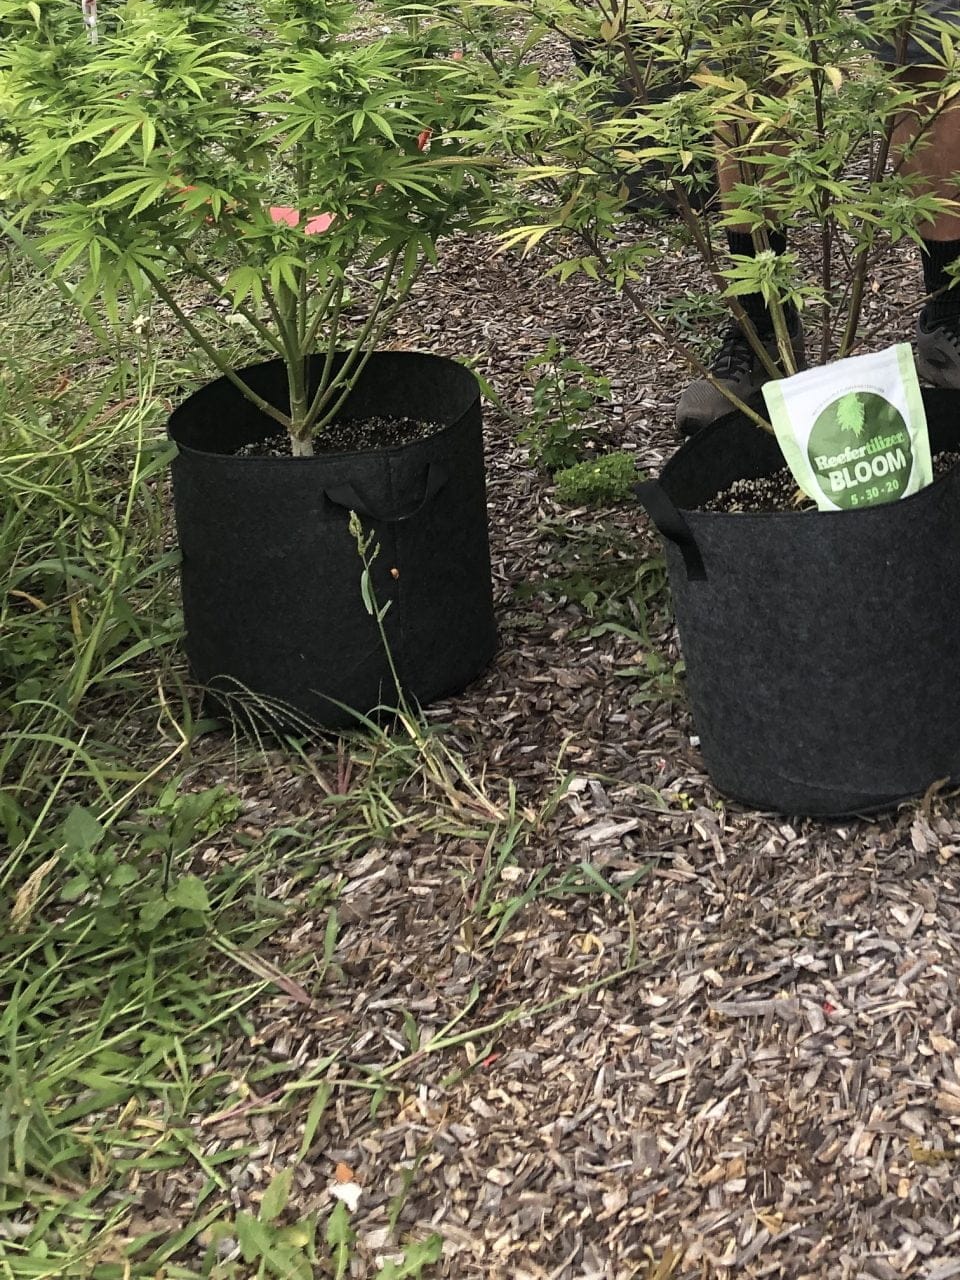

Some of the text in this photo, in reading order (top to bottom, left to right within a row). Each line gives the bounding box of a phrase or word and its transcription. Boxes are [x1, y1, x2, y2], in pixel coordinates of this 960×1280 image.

[814, 431, 906, 470] Reefertilizer
[828, 448, 907, 492] BLOOM
[850, 494, 859, 506] 5
[866, 487, 879, 500] 30
[886, 479, 899, 494] 20
